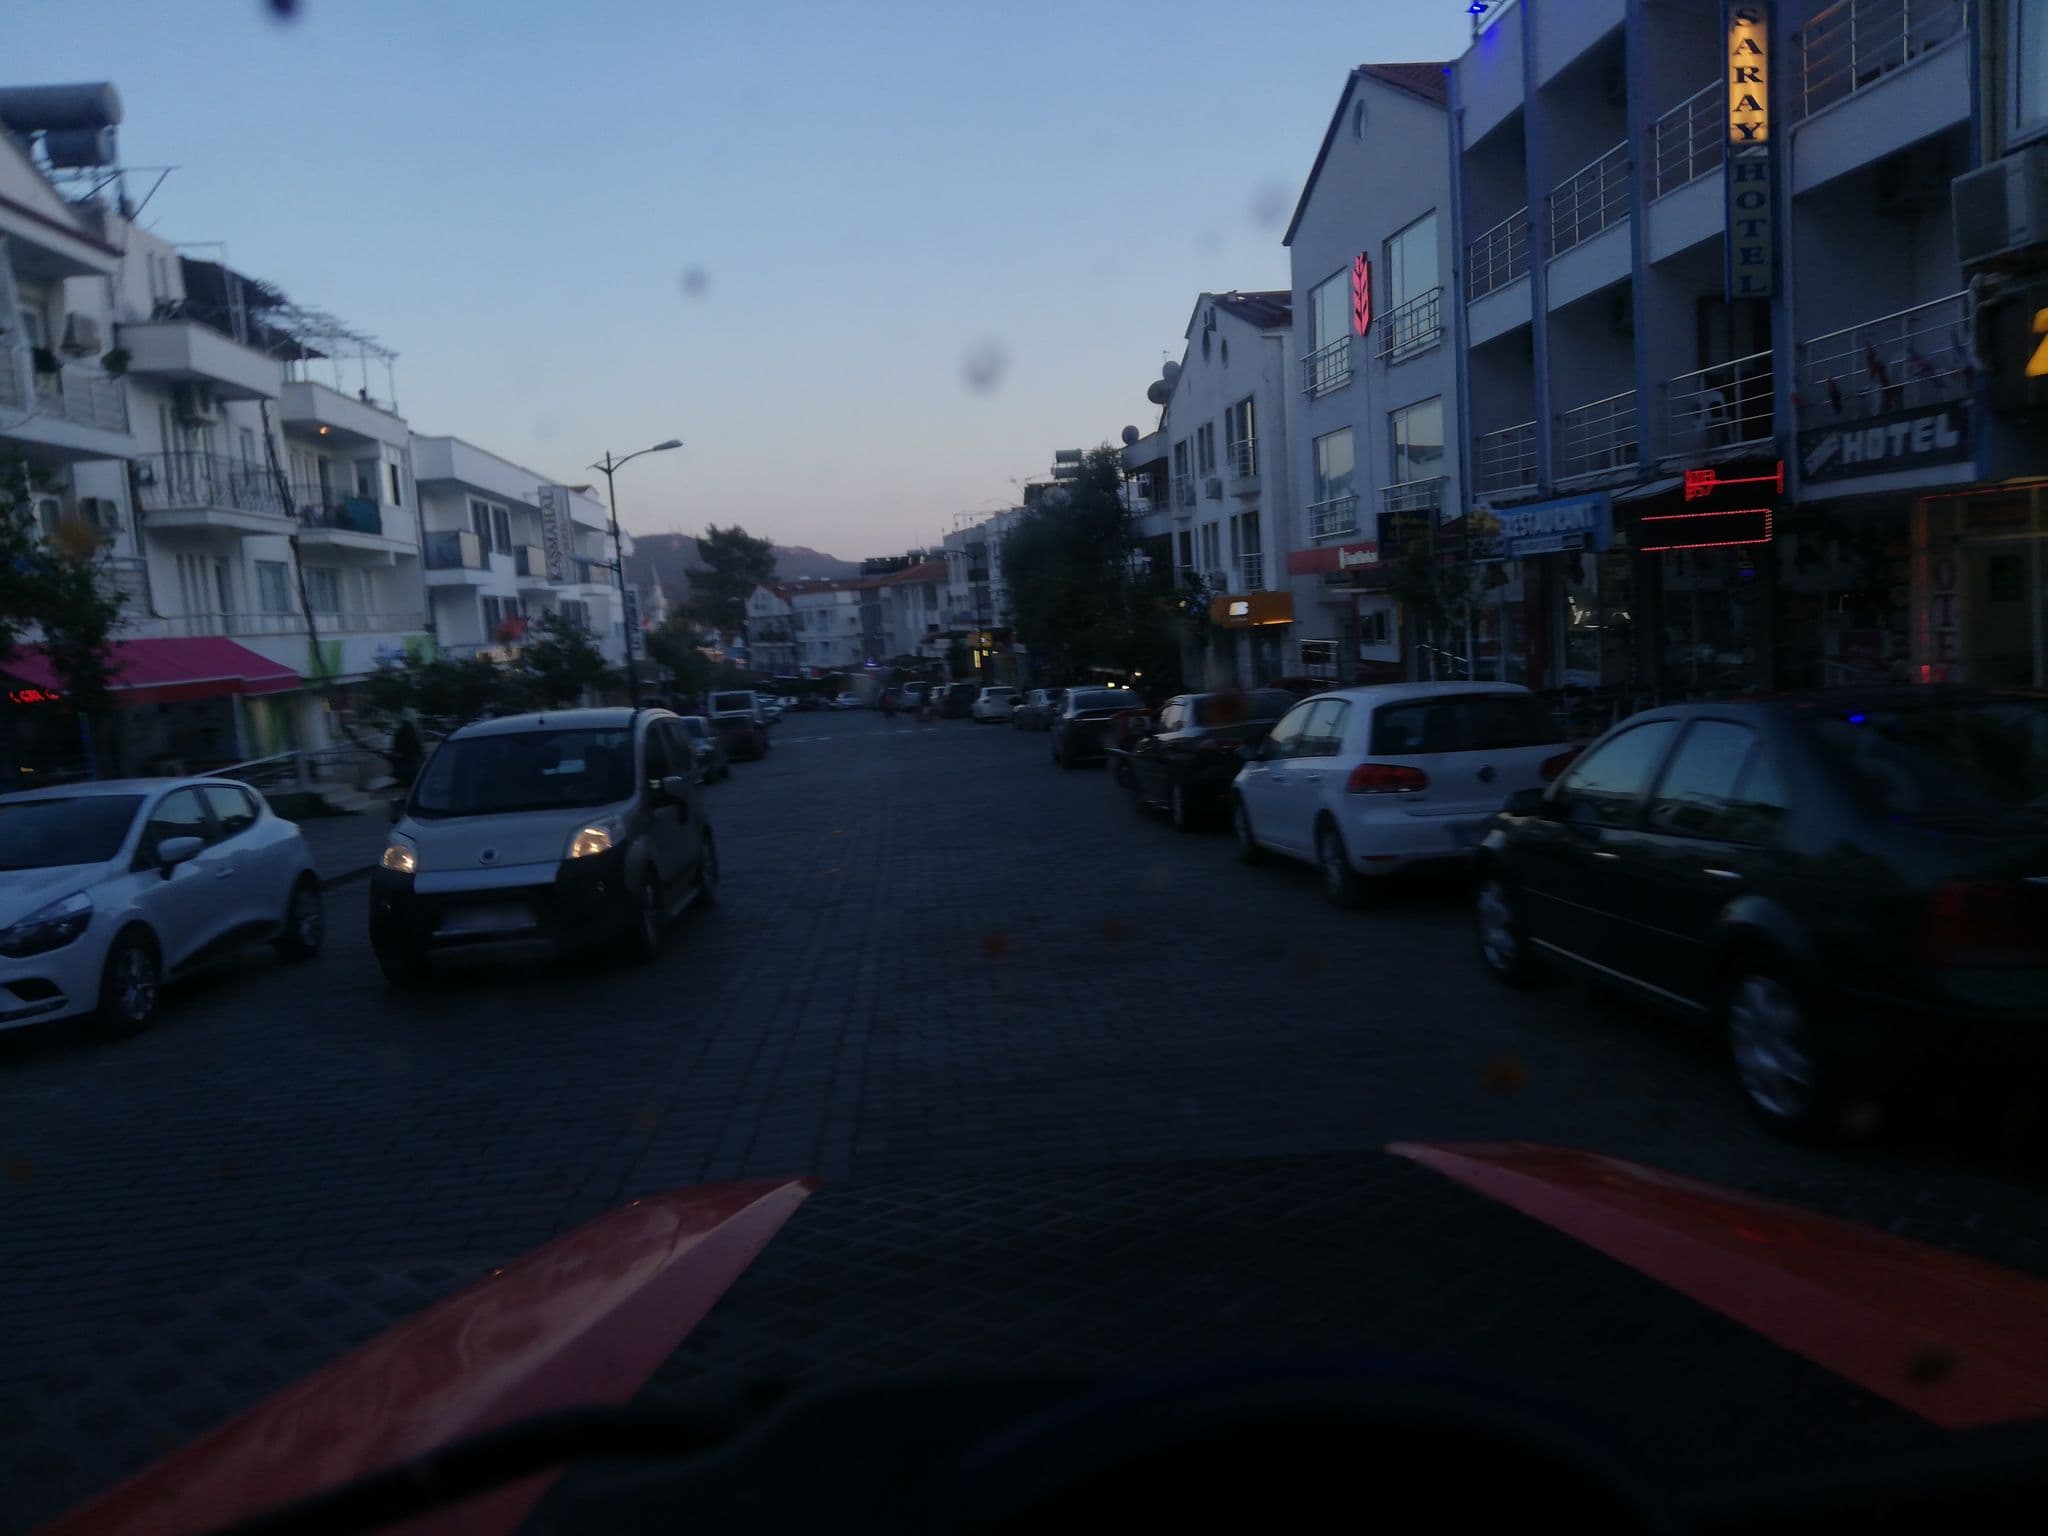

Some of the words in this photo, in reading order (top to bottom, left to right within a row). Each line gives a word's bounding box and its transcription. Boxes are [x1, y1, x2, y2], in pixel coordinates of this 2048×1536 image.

[1733, 7, 1763, 141] SARAY
[1734, 162, 1767, 294] HOTEL
[1842, 412, 1961, 465] HOTEL
